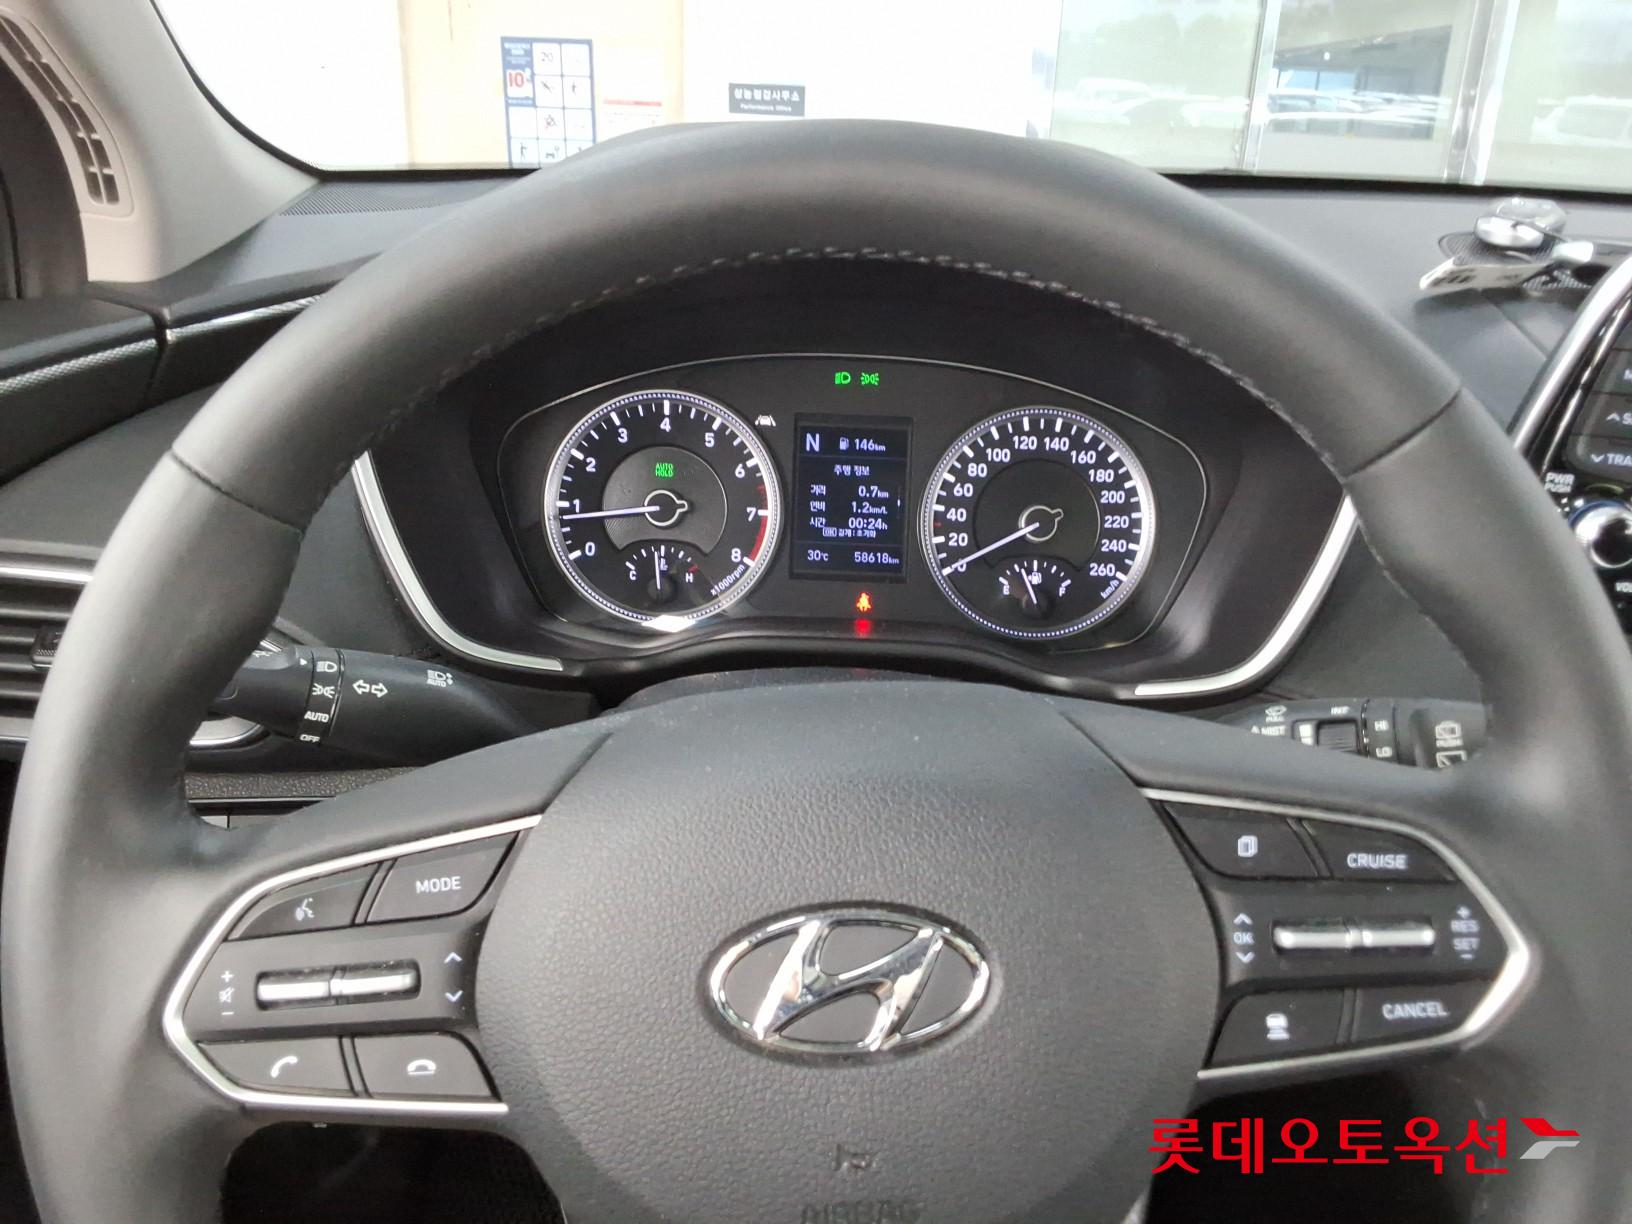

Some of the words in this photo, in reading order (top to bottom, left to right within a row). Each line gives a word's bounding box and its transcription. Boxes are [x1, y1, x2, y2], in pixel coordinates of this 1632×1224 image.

[660, 416, 671, 433] 4
[617, 428, 628, 443] 3
[704, 432, 715, 448] 5
[805, 433, 820, 452] N
[1012, 435, 1037, 450] 120
[1044, 437, 1069, 451] 140
[985, 448, 1011, 463] 100
[1070, 450, 1096, 464] 160
[585, 457, 596, 472] 2
[735, 463, 745, 479] 6
[967, 463, 988, 478] 80
[1088, 468, 1114, 483] 180
[1546, 472, 1575, 485] PWR
[953, 483, 974, 497] 60
[1100, 490, 1126, 504] 200
[572, 499, 580, 512] 1
[746, 507, 757, 522] 7
[946, 507, 967, 522] 40
[1104, 515, 1129, 529] 220
[948, 532, 968, 547] 20
[1101, 539, 1127, 553] 240
[585, 541, 596, 556] 0
[731, 547, 742, 562] 8
[629, 570, 637, 581] C
[1089, 563, 1116, 577] 260
[685, 573, 693, 583] H
[426, 678, 447, 688] AUTO
[304, 710, 330, 723] AUTO
[300, 733, 321, 743] OFF
[1347, 853, 1408, 870] CRUISE
[415, 876, 462, 894] MODE
[1233, 932, 1254, 945] OK
[1382, 1001, 1449, 1020] CANCEL
